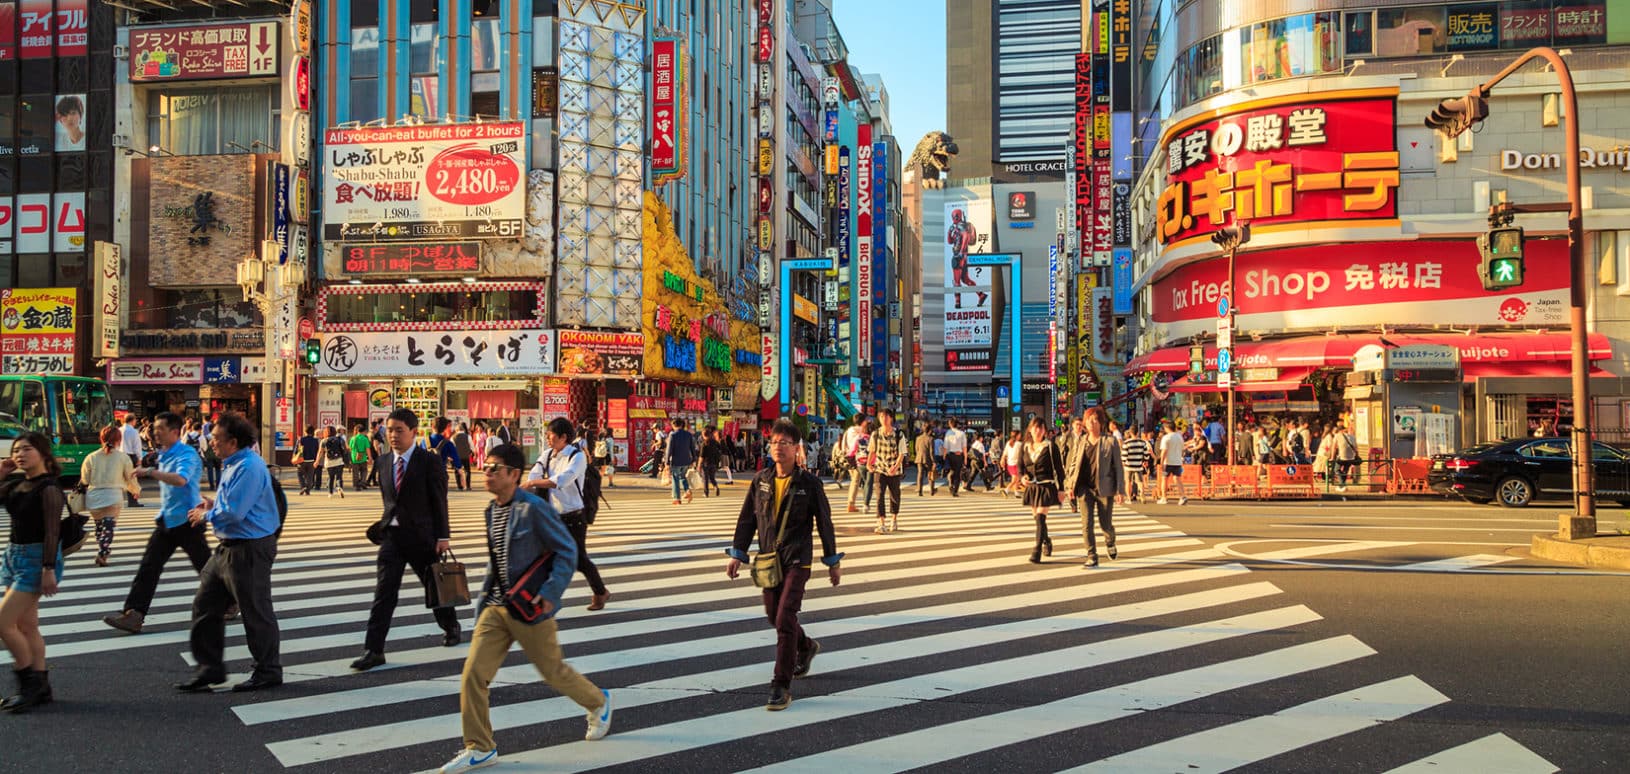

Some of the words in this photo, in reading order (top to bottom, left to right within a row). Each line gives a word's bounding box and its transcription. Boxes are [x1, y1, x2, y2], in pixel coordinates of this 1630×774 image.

[21, 10, 87, 32] アイフル
[1448, 13, 1493, 35] 販売
[1503, 14, 1548, 29] ブランド
[1558, 10, 1602, 25] 時計
[136, 28, 247, 47] ブランド高価買取
[1114, 0, 1130, 63] キホーテ
[226, 48, 246, 58] TAX
[225, 59, 246, 70] FREE
[253, 58, 272, 70] 1F
[656, 54, 671, 100] 居酒屋
[329, 129, 415, 143] All-you-can-eat
[418, 127, 452, 139] buffet
[455, 127, 472, 137] for
[475, 126, 484, 137] 2
[487, 126, 521, 137] hours
[653, 110, 673, 148] つぼ八
[1168, 108, 1326, 174] 驚安の殿堂
[333, 146, 424, 167] しゃぶしゃぶ
[1501, 149, 1561, 171] Don
[1006, 163, 1034, 172] HOTEL
[435, 168, 497, 198] 2,480
[857, 145, 871, 216] SHIDAX
[416, 225, 458, 235] USAGIYA
[499, 221, 521, 235] 5F
[860, 243, 869, 262] BIC
[860, 265, 869, 297] DRUG
[1344, 262, 1443, 291] 免税店
[1172, 284, 1188, 312] Tax
[1191, 278, 1231, 307] Free
[1245, 268, 1331, 301] Shop
[23, 305, 72, 329] 金の蔵
[946, 310, 990, 321] DEADPOOL
[1544, 313, 1562, 321] Shop
[561, 332, 616, 344] OKONOMI
[619, 335, 644, 344] YAKI
[407, 333, 528, 367] とらそば
